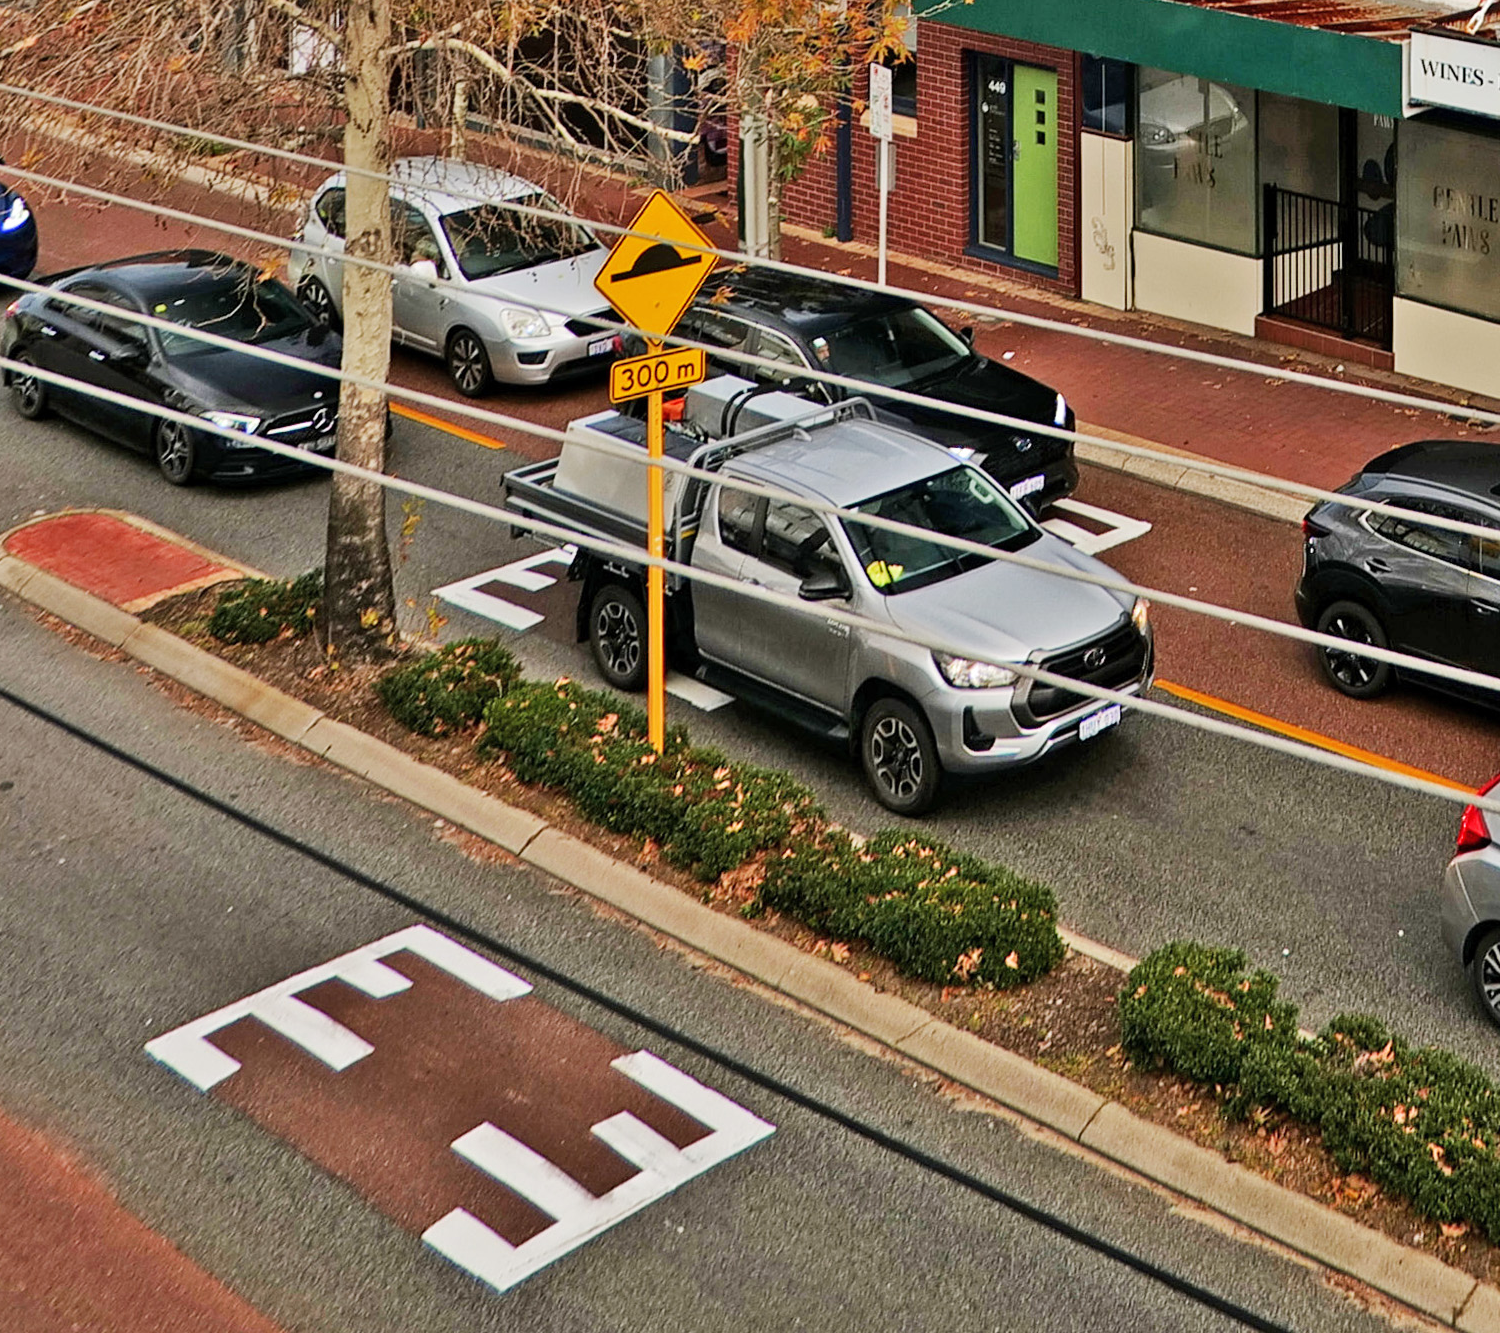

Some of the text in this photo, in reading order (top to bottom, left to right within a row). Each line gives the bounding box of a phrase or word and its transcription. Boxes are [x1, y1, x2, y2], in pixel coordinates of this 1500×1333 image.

[1420, 57, 1485, 87] WINES
[988, 80, 1006, 95] 449
[621, 360, 695, 392] 300 m
